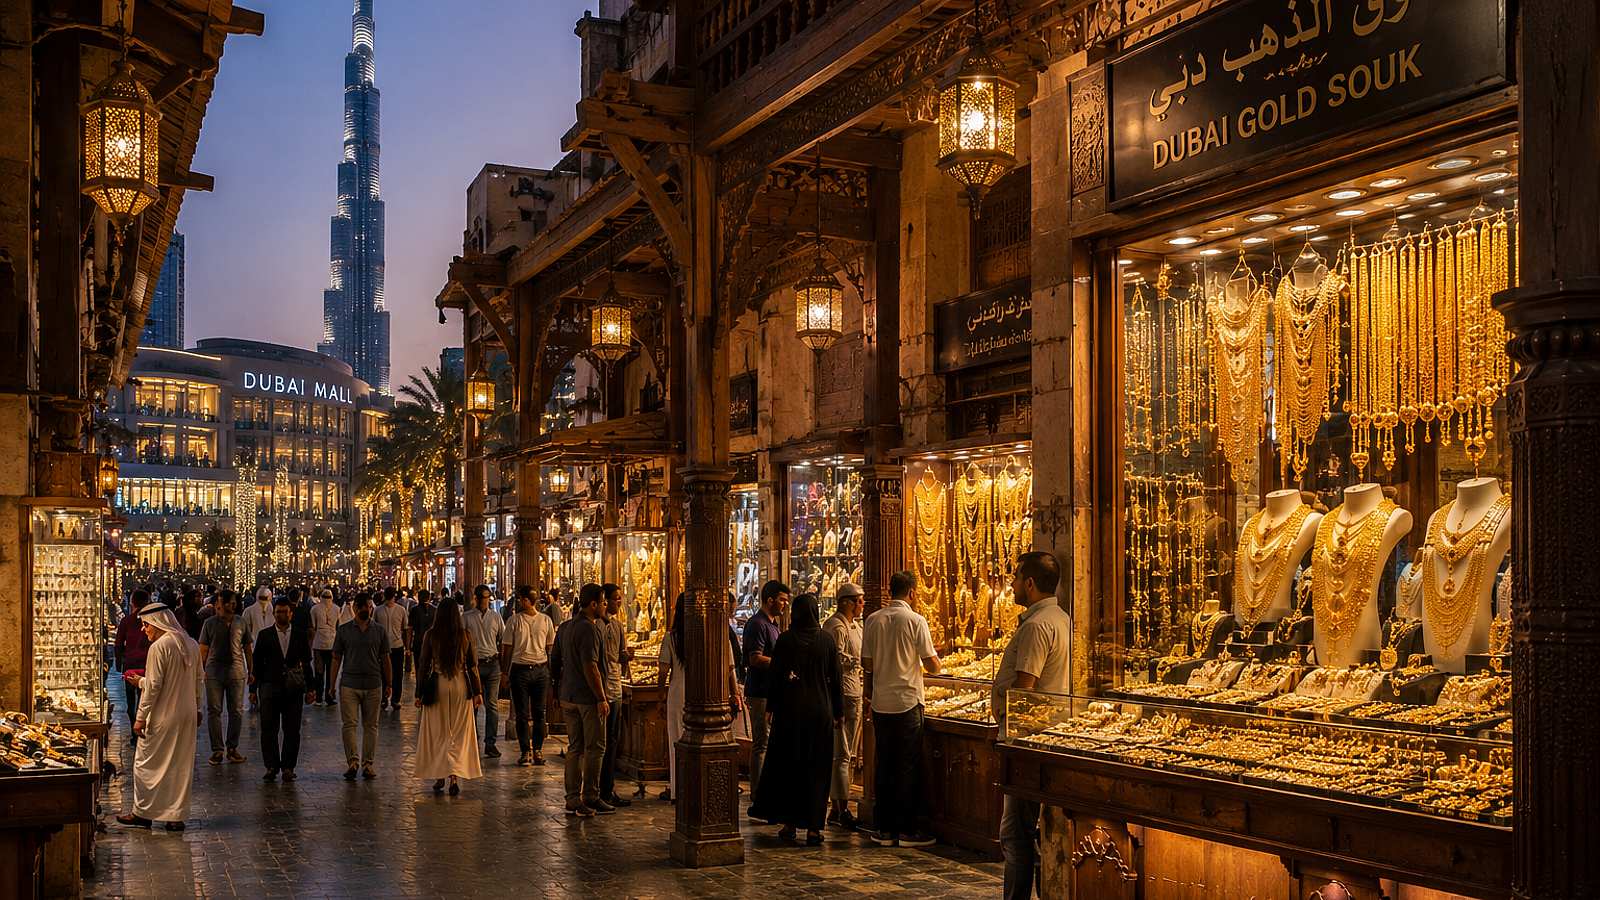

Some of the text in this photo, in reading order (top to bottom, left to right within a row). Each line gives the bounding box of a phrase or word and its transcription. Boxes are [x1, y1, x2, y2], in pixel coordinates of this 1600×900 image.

[1152, 115, 1228, 170] DUBAI
[1237, 85, 1318, 138] GOLD
[1327, 42, 1423, 108] SOUK
[243, 371, 353, 404] DUBAI MALL
